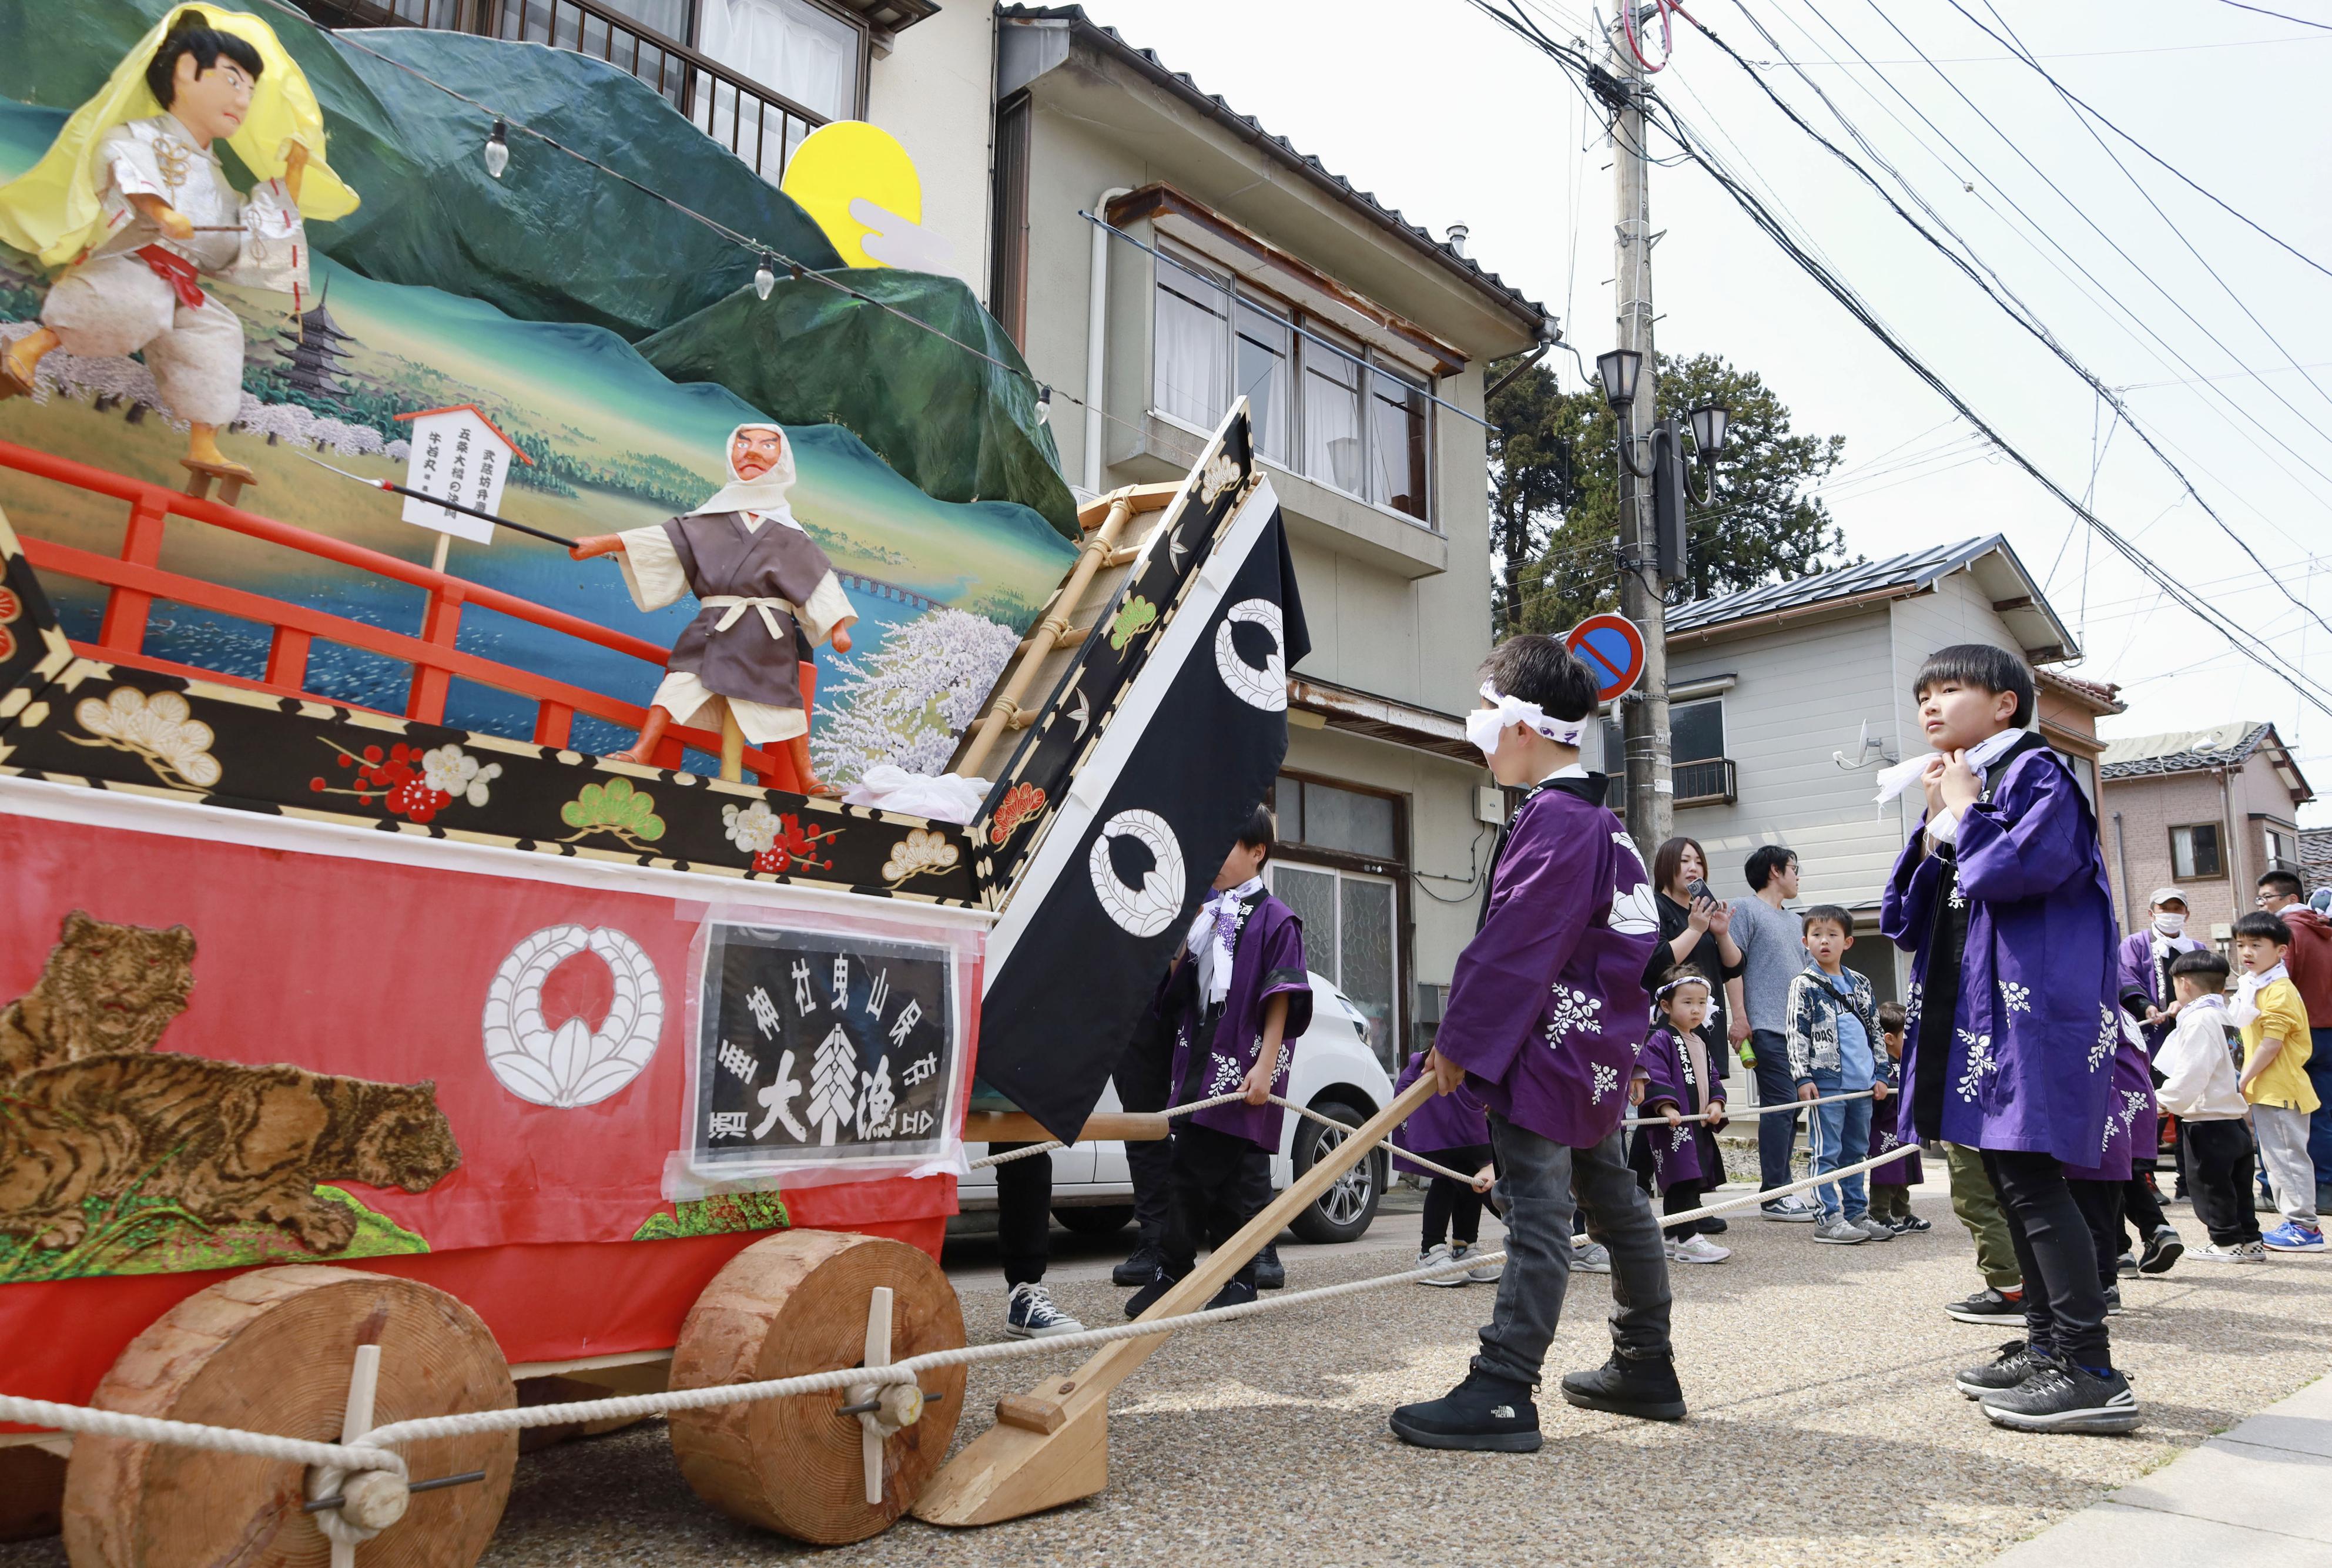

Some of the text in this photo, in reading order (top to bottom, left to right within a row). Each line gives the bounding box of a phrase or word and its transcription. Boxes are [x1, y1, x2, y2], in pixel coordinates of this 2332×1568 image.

[423, 431, 442, 472] 牛若丸
[1672, 1036, 1696, 1084] 酒垂曳山祭
